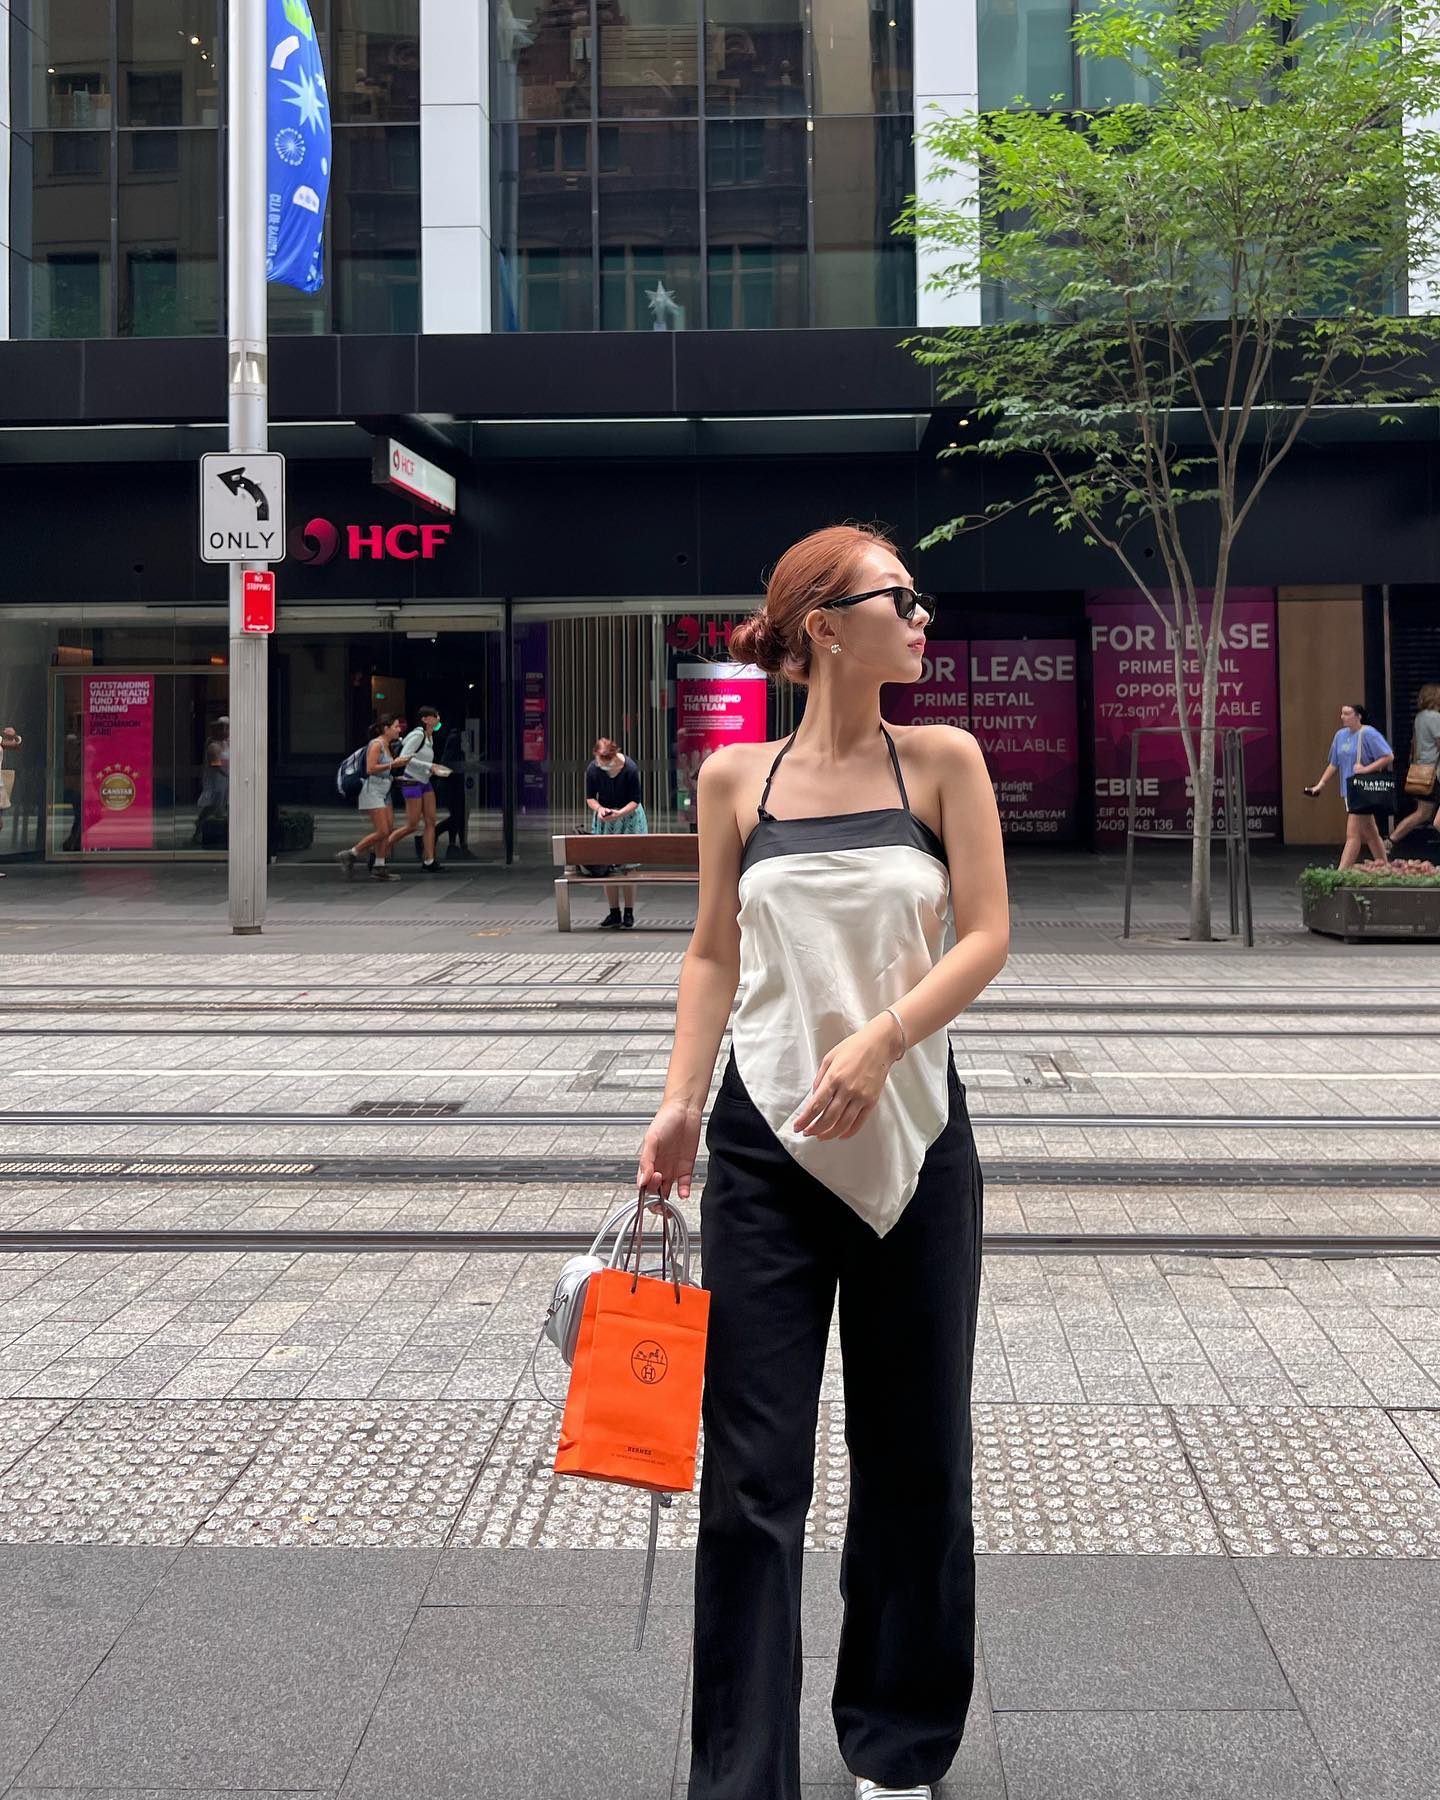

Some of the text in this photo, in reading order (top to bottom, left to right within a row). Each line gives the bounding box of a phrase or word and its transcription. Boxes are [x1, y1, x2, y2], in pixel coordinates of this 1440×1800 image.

[402, 455, 415, 476] HCF
[209, 532, 275, 549] ONLY
[346, 524, 451, 560] HCF
[254, 575, 263, 583] NO
[246, 583, 271, 592] STOPPING
[1091, 625, 1155, 651] FOR
[916, 656, 1074, 684] OR LEASE
[1119, 660, 1239, 674] PRIME REAIL
[90, 681, 150, 690] OUTSTANDING
[1116, 682, 1244, 698] OPPORUITY
[90, 689, 150, 697] VALUE HEALTH
[683, 695, 741, 703] TEAM BEHIND
[90, 697, 113, 705] FUND
[121, 697, 148, 705] YEARS
[913, 692, 1035, 707] PRIME RETAIL
[90, 705, 128, 713] RUNNING
[683, 703, 727, 711] THE TEAM
[911, 715, 1037, 730] OPPORTUNITY
[981, 738, 1067, 753] VAILABLE
[1001, 781, 1033, 793] Knight
[1095, 777, 1160, 797] CBRE
[1001, 792, 1028, 803] Frank
[1096, 807, 1116, 817] EIF
[1011, 821, 1034, 833] 045
[1153, 818, 1174, 831] 136
